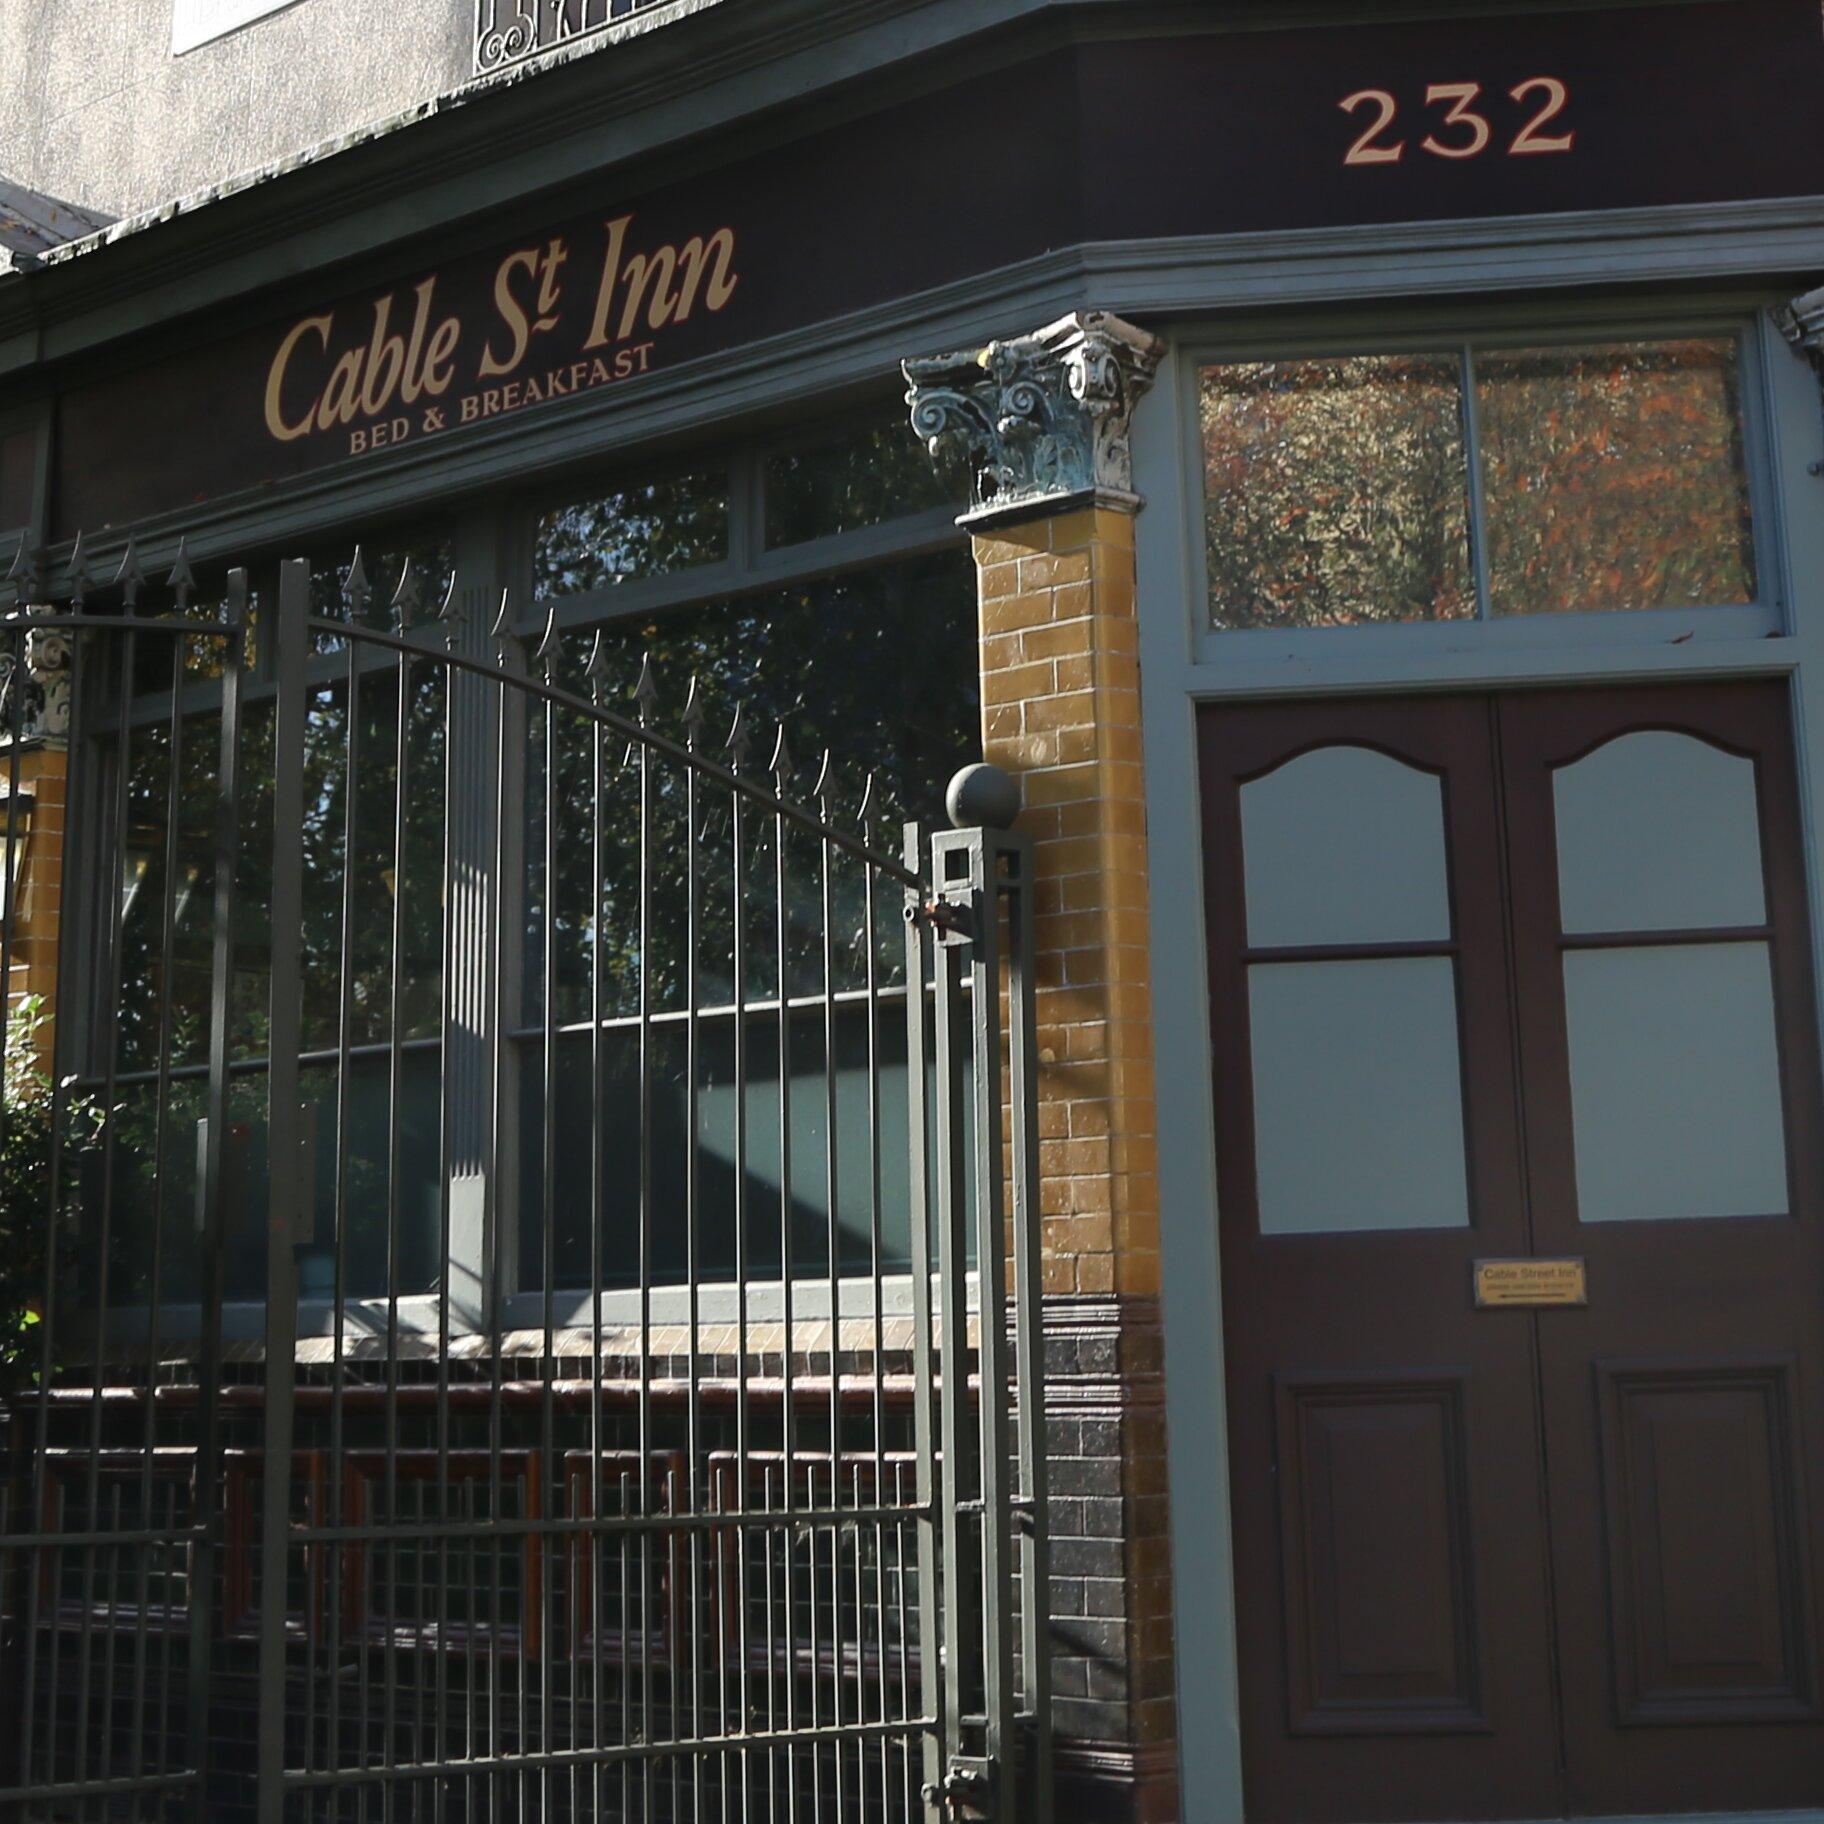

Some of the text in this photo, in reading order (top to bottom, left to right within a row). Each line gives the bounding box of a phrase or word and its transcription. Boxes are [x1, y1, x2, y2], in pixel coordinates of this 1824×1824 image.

[1337, 76, 1576, 166] 232
[263, 213, 739, 442] Cable St Inn
[348, 341, 656, 455] BED & BREAKFAST
[1483, 1266, 1577, 1280] Cable Street Inn
